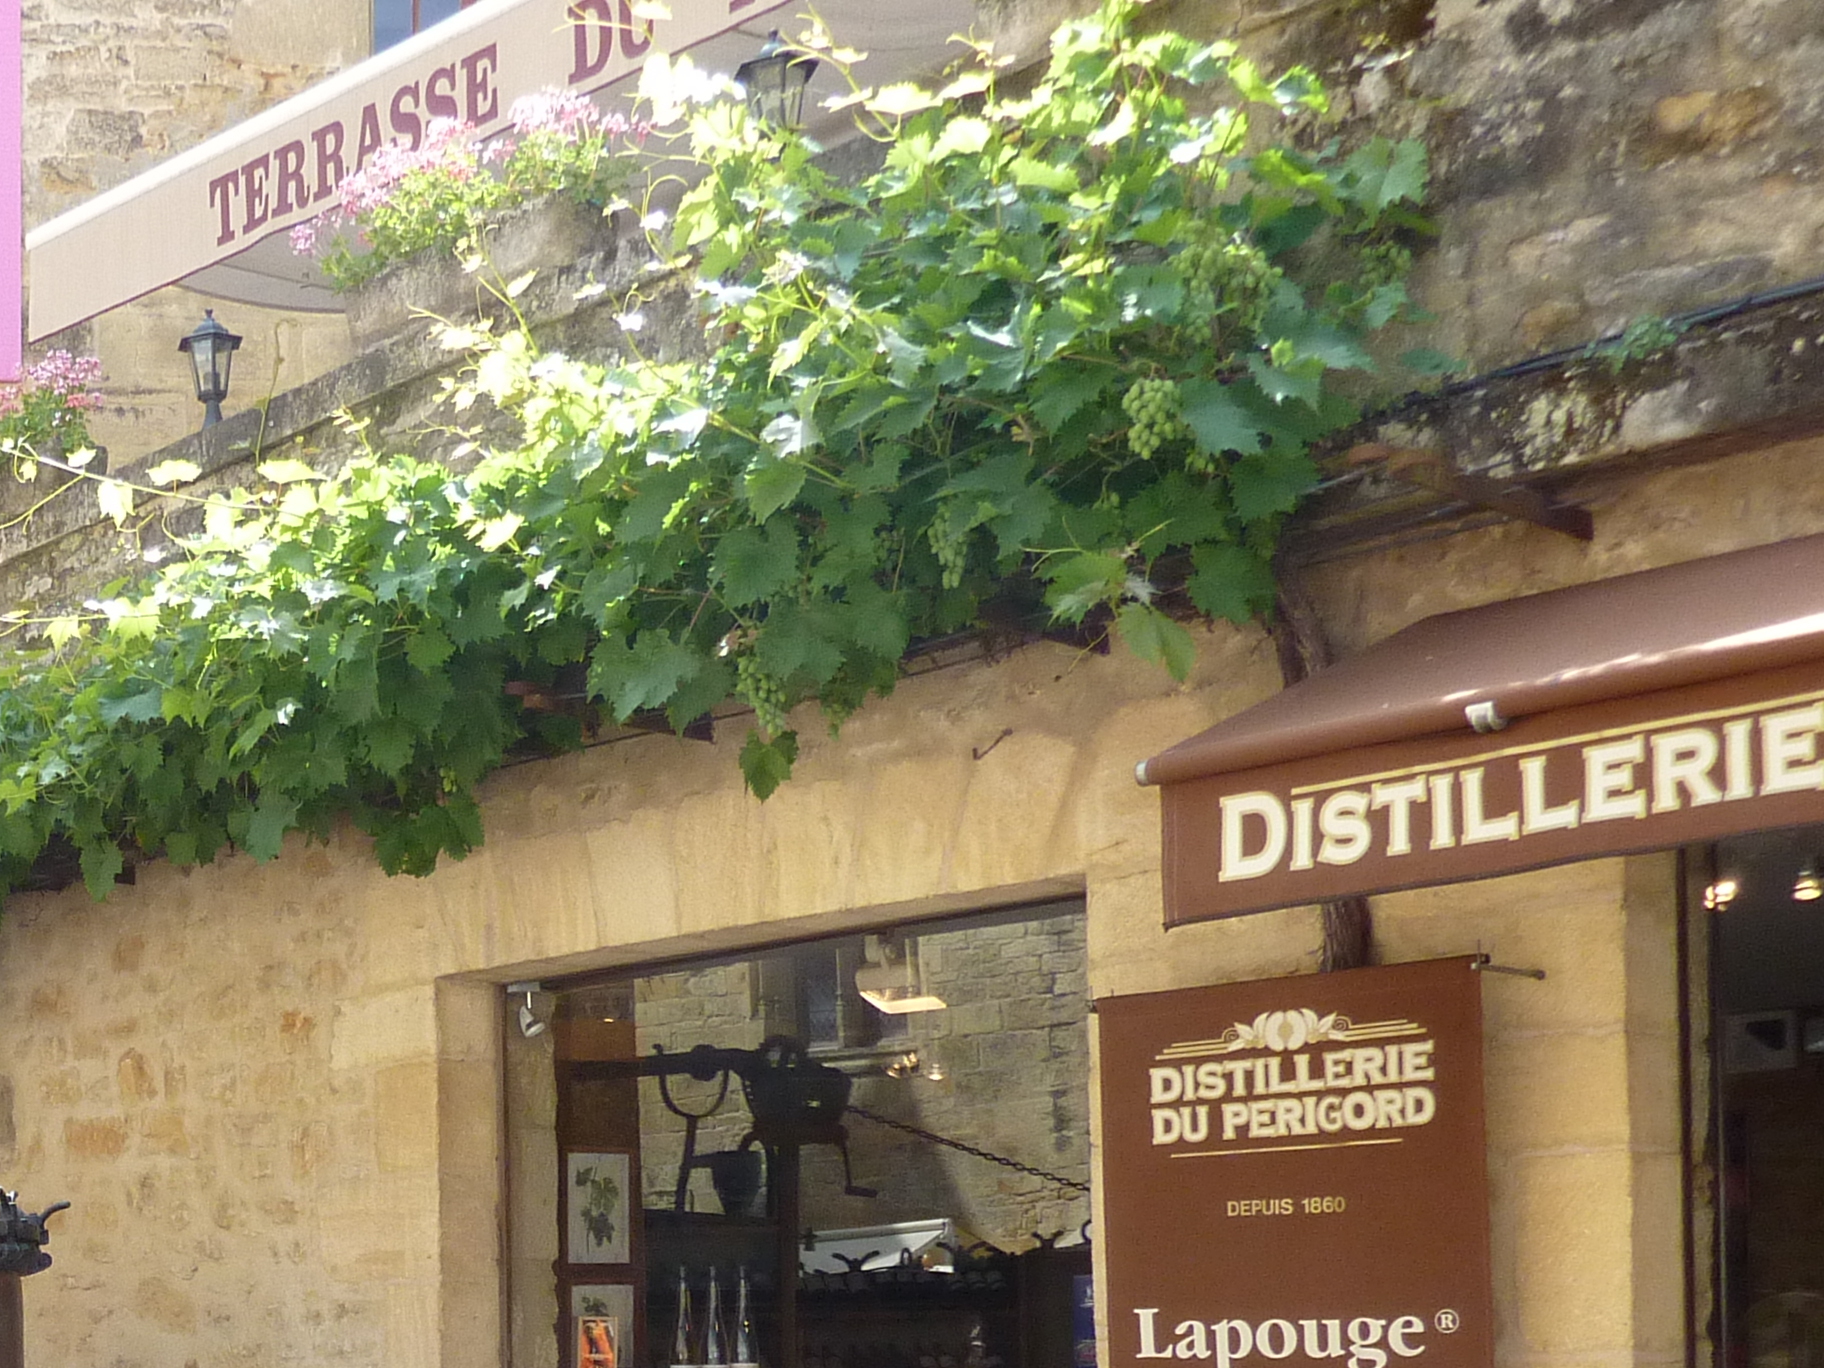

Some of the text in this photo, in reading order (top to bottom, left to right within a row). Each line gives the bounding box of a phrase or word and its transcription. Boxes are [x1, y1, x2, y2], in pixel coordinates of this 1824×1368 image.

[208, 41, 498, 248] TERRASSE
[1218, 700, 1824, 883] DISTILLERIE
[1149, 1039, 1435, 1105] DISTILLERIE
[1151, 1087, 1436, 1146] DU PERIGORD
[1227, 1195, 1346, 1217] DEPUIS 1860
